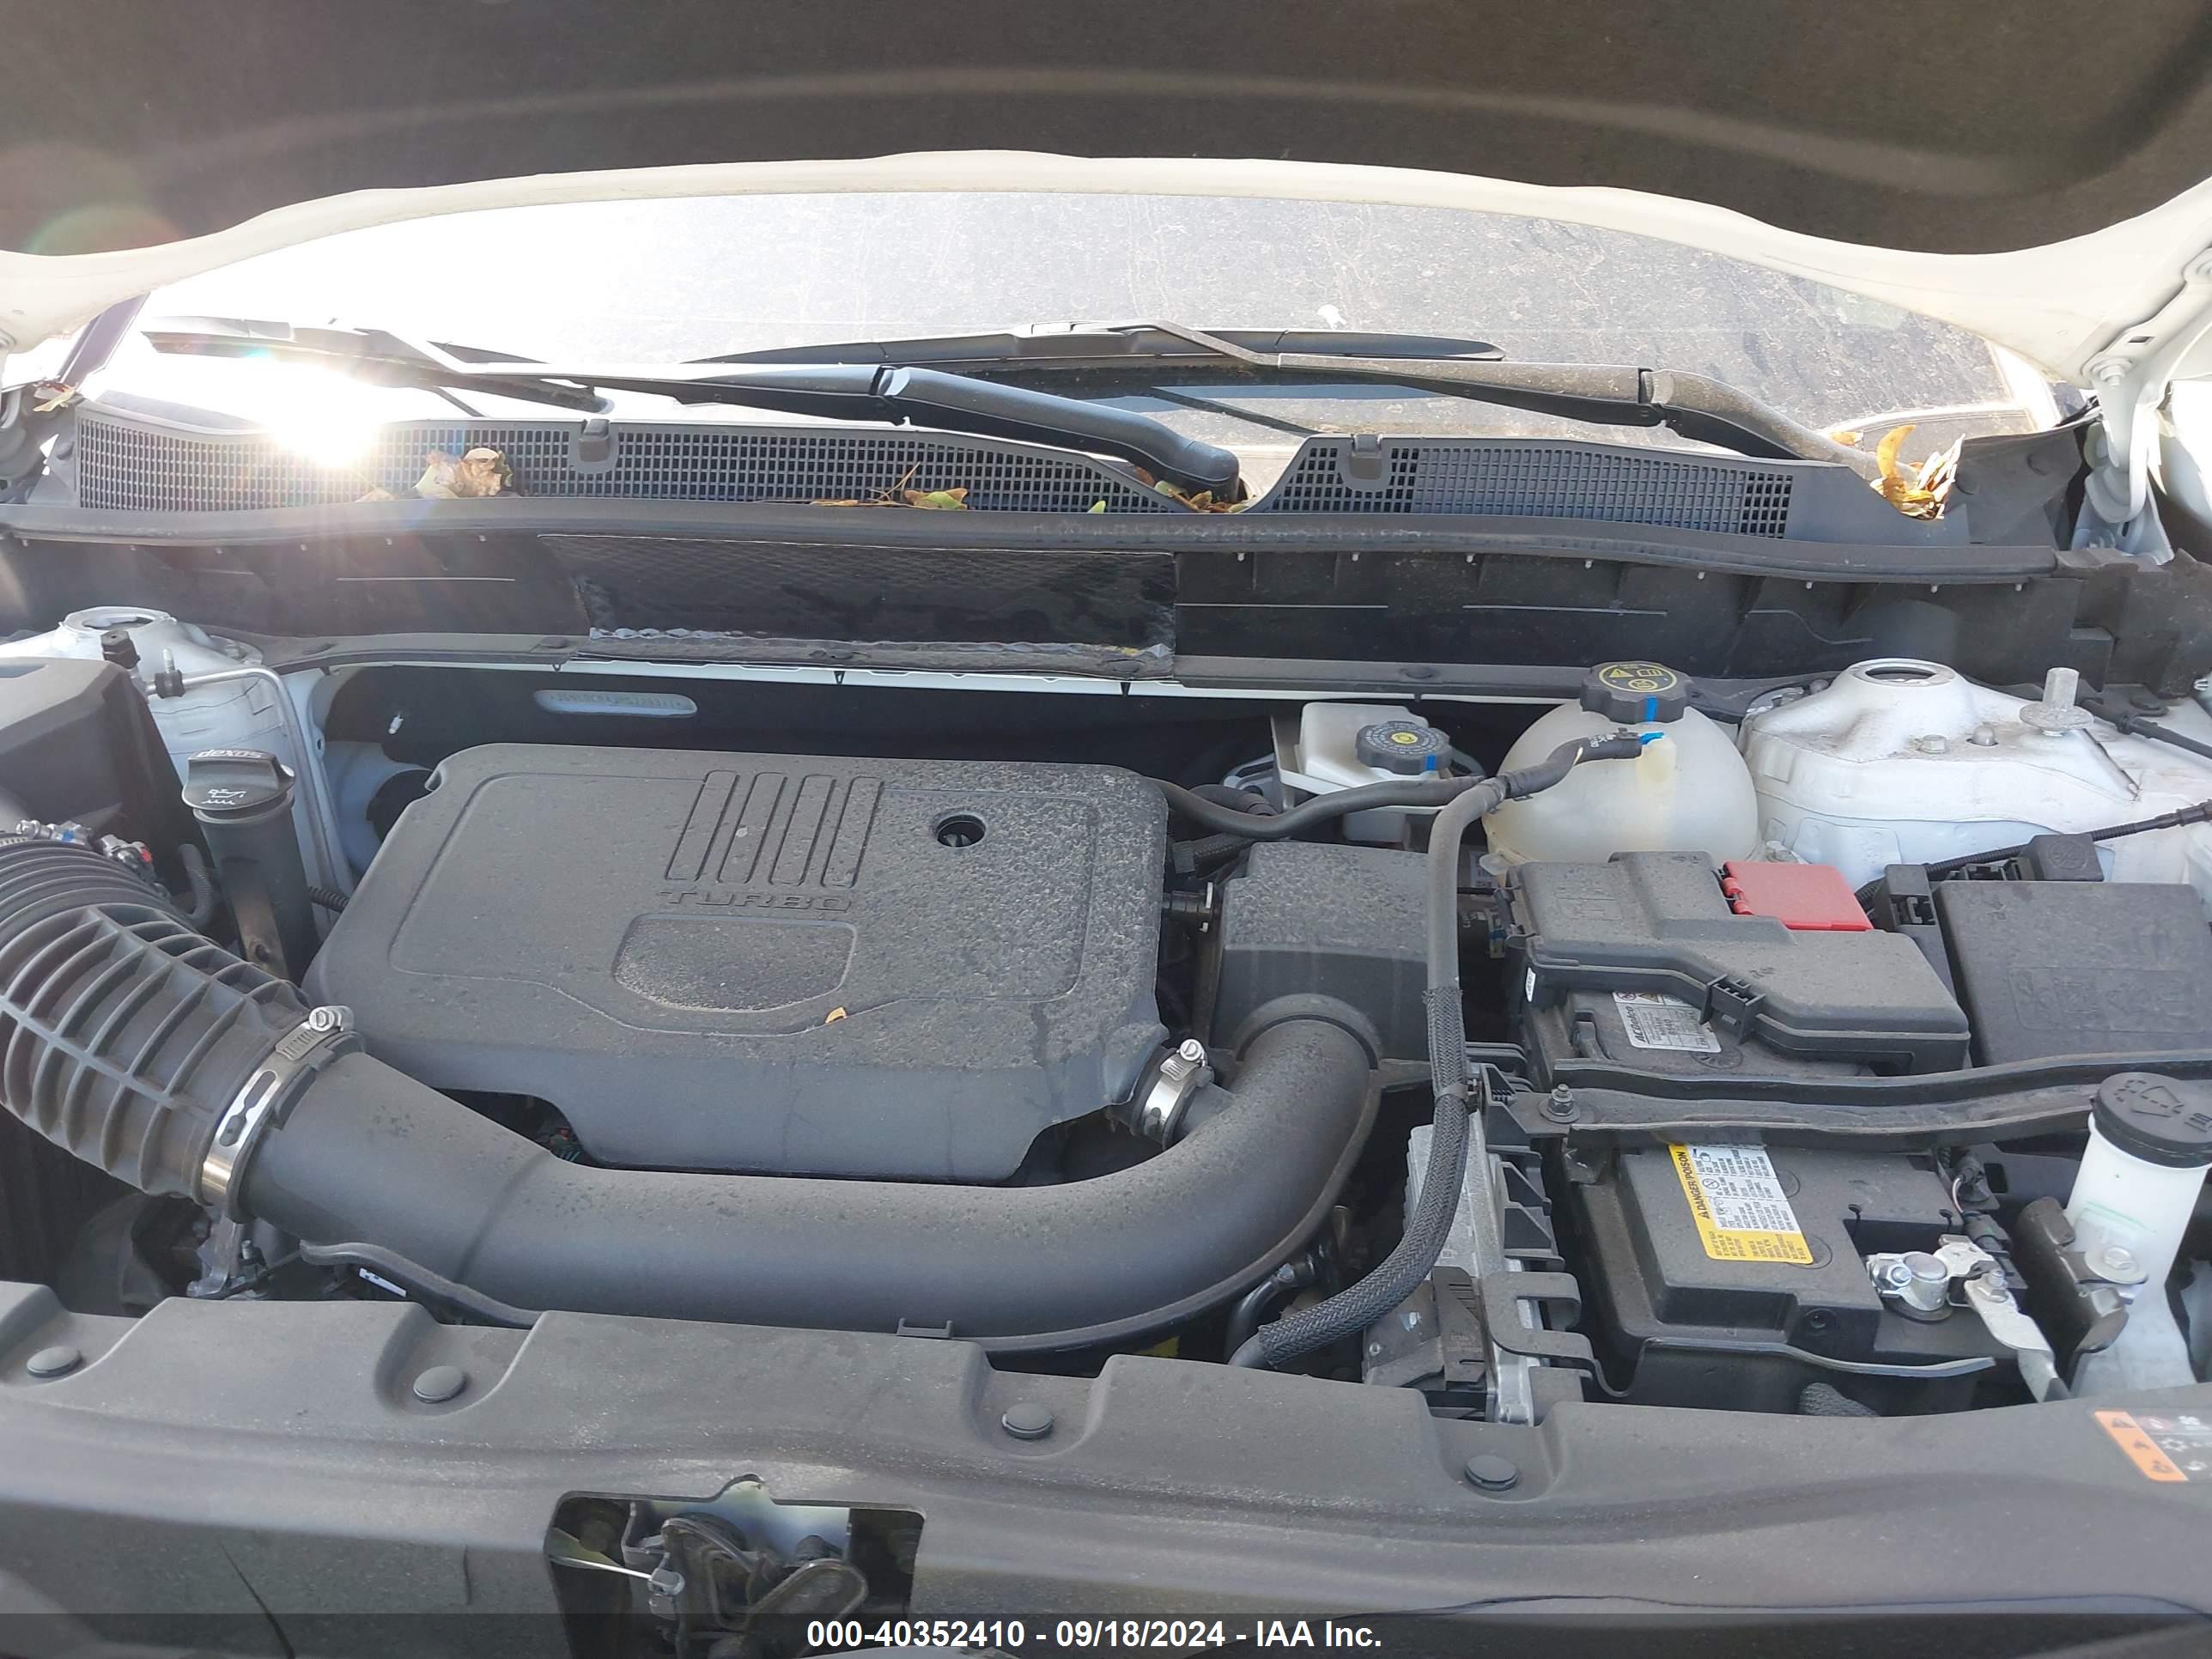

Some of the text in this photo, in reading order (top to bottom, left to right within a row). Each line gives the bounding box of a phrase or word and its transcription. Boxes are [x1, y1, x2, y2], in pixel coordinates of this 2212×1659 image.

[196, 749, 264, 758] dexos
[656, 890, 853, 912] TURBO
[1625, 1006, 1646, 1042] ACDelco
[1675, 1151, 1708, 1211] DANGER/POISON
